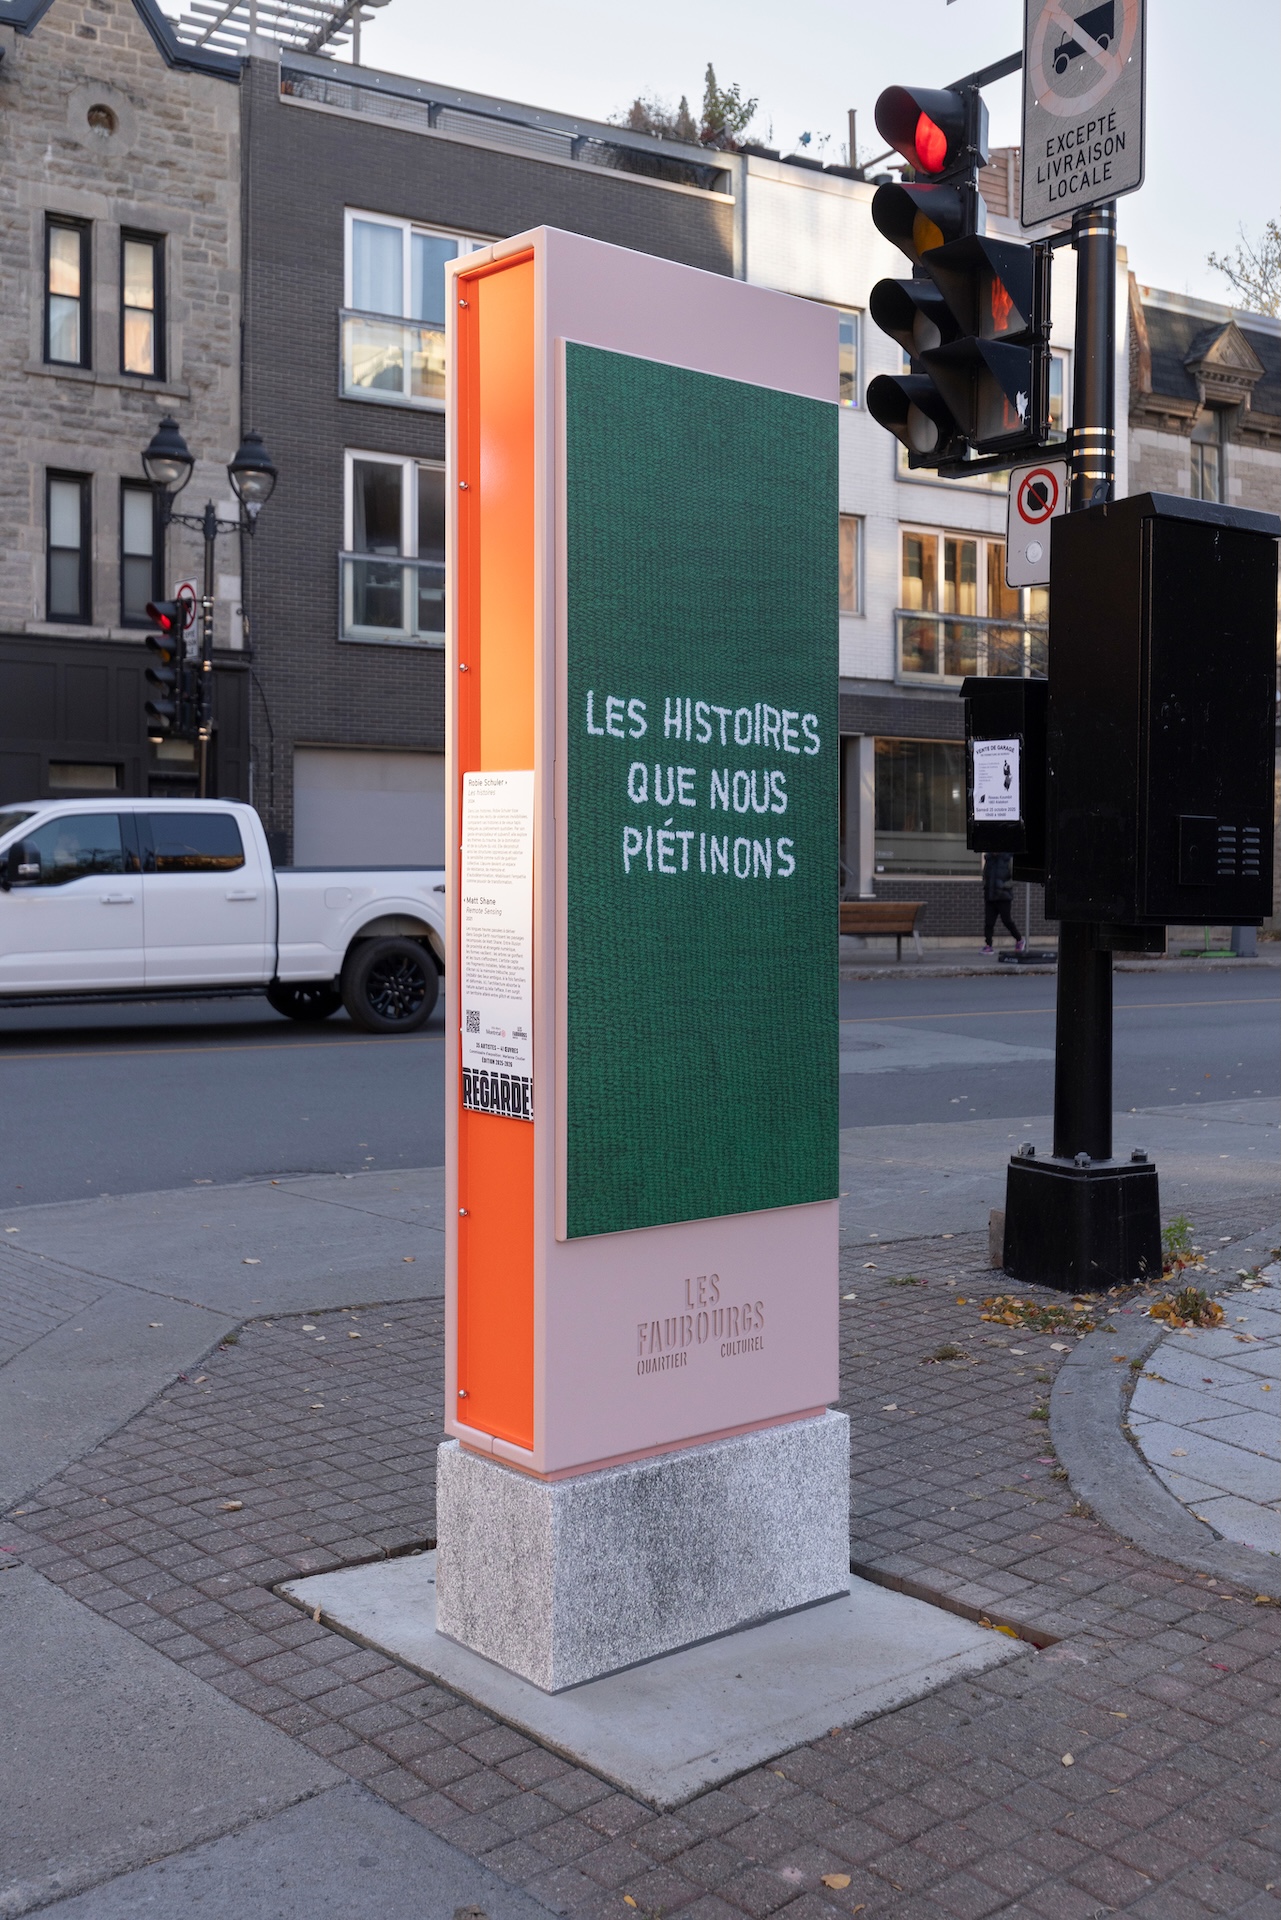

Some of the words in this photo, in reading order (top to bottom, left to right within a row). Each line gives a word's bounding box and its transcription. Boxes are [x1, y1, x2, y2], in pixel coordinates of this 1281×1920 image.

[1037, 131, 1126, 184] LIVRAISON
[1046, 107, 1117, 158] EXCEPTÉ
[1048, 161, 1112, 202] LOCALE
[586, 690, 648, 739] LES
[664, 697, 820, 755] HISTOIRES
[975, 745, 990, 755] VENTE
[997, 744, 1015, 753] GARAGE
[627, 762, 697, 807] QUE
[710, 768, 788, 814] NOUS
[623, 817, 796, 879] PIÉTINONS
[466, 896, 479, 905] Matt
[479, 896, 496, 906] Shane
[684, 1273, 721, 1311] LES
[637, 1301, 765, 1356] FAUBOURGS
[636, 1352, 687, 1376] QUARTIER
[720, 1336, 764, 1358] CULTUREL
